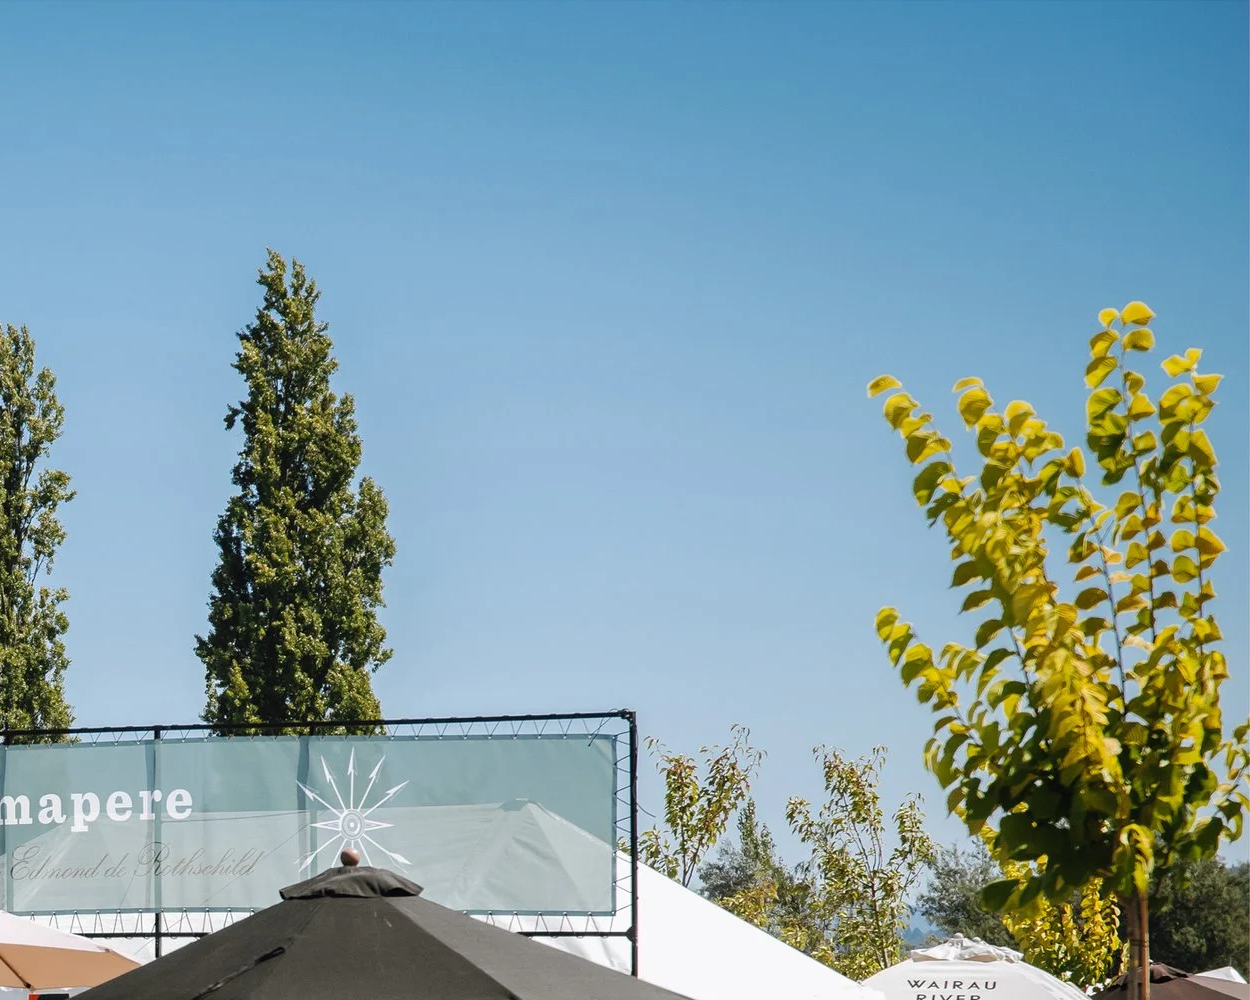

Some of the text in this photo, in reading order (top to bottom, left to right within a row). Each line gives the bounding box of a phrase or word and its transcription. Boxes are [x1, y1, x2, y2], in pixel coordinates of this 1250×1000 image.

[10, 845, 108, 881] Edmond
[104, 852, 129, 878] de
[134, 841, 264, 877] Rothschild
[907, 979, 997, 990] WAIRAU
